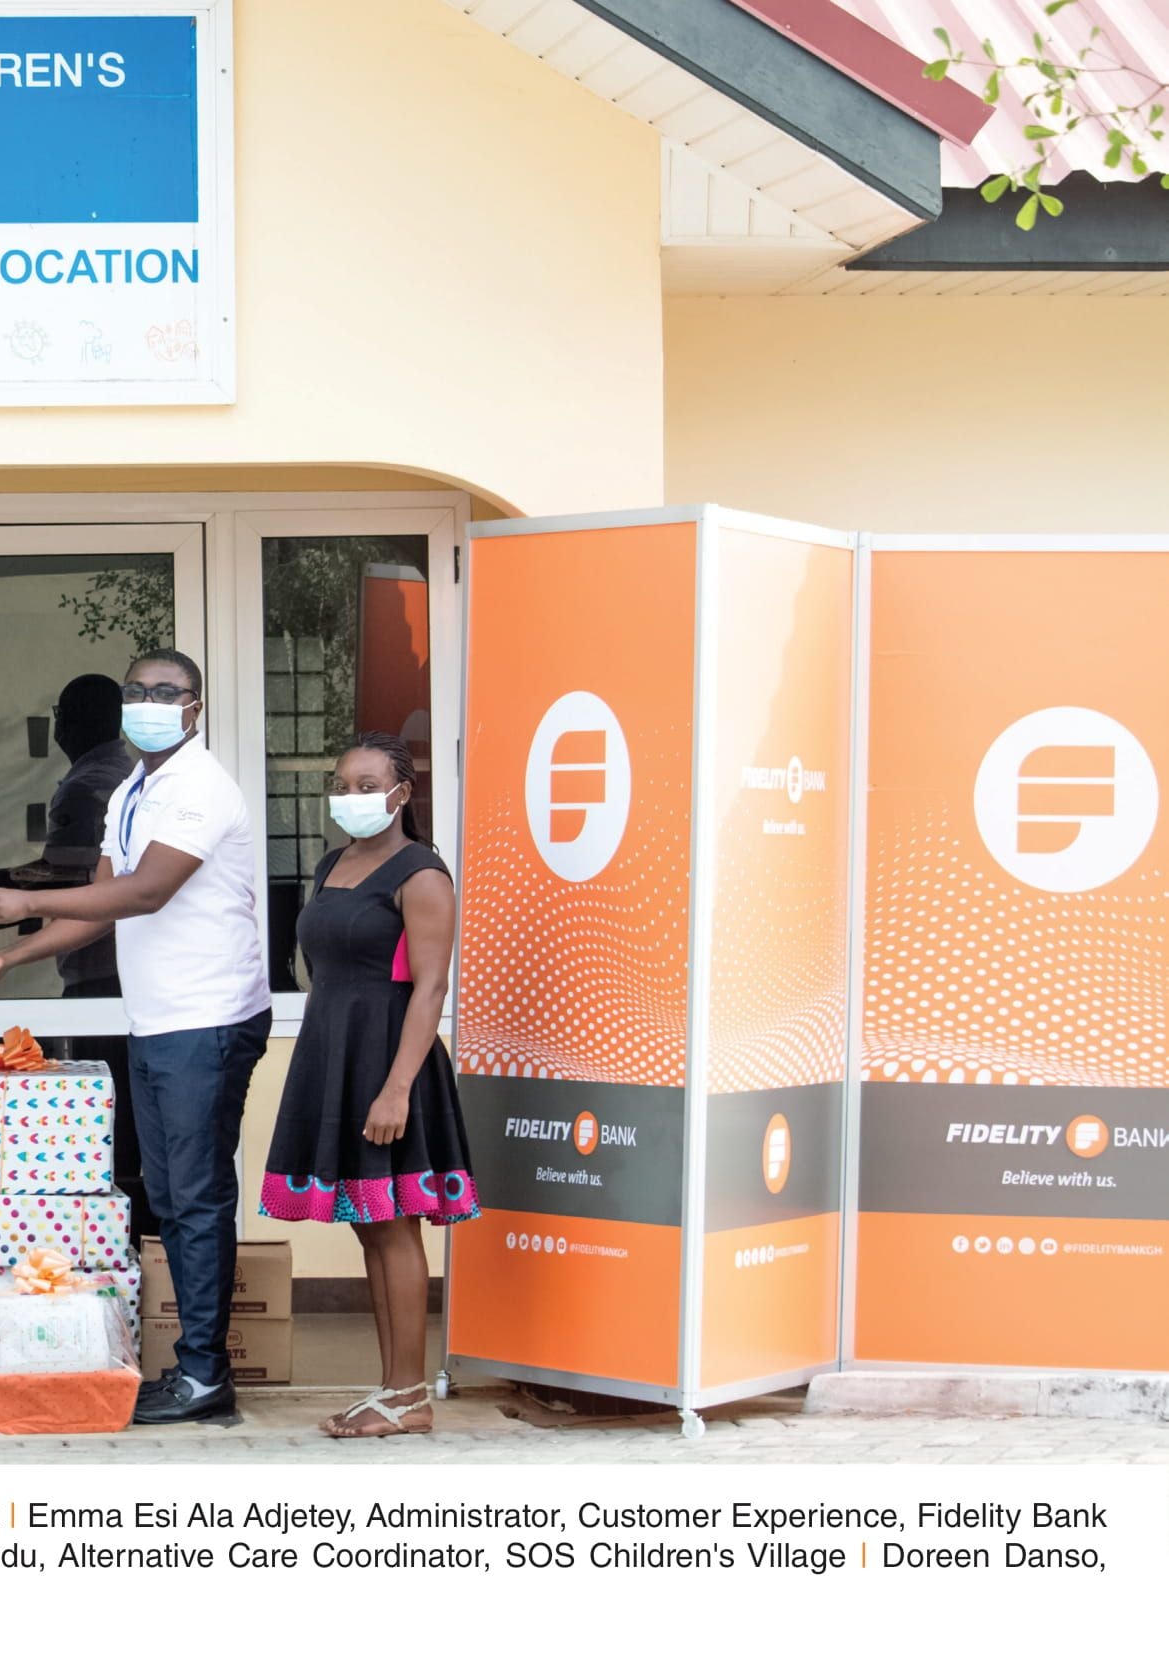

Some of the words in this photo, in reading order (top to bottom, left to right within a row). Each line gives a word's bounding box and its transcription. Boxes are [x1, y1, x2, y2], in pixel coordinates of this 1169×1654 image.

[505, 1117, 572, 1141] FIDELITY
[601, 1124, 637, 1147] BANK
[946, 1123, 1062, 1145] FIDELITY
[535, 1167, 566, 1183] Believe
[568, 1169, 588, 1185] with
[590, 1173, 603, 1186] us.
[1002, 1170, 1054, 1186] Believe
[1057, 1171, 1092, 1187] with
[1096, 1175, 1117, 1188] us.
